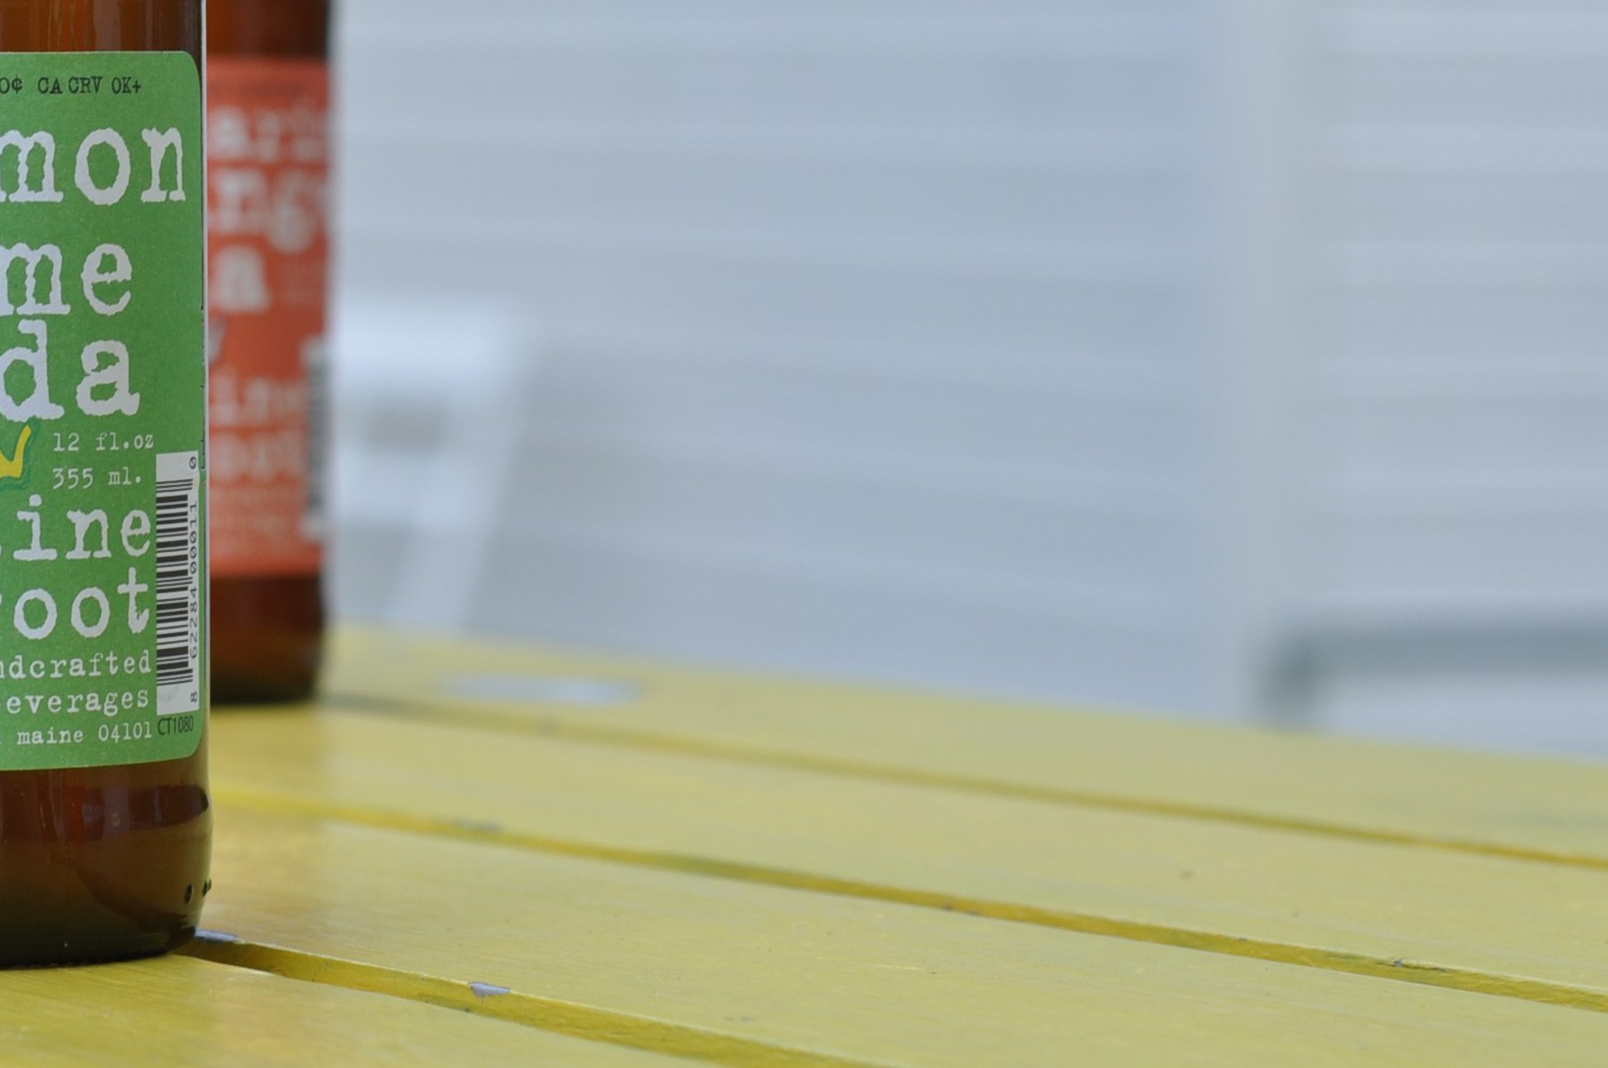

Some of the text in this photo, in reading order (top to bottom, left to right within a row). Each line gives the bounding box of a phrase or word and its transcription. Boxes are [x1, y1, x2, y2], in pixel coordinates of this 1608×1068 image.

[37, 76, 63, 95] CA
[68, 76, 103, 95] CRV
[111, 76, 142, 95] OK+
[53, 432, 155, 451] 12 fl.oz
[52, 467, 142, 489] 355 ml.
[17, 727, 85, 745] maine
[97, 722, 152, 744] 04101
[157, 714, 194, 736] CT1080
